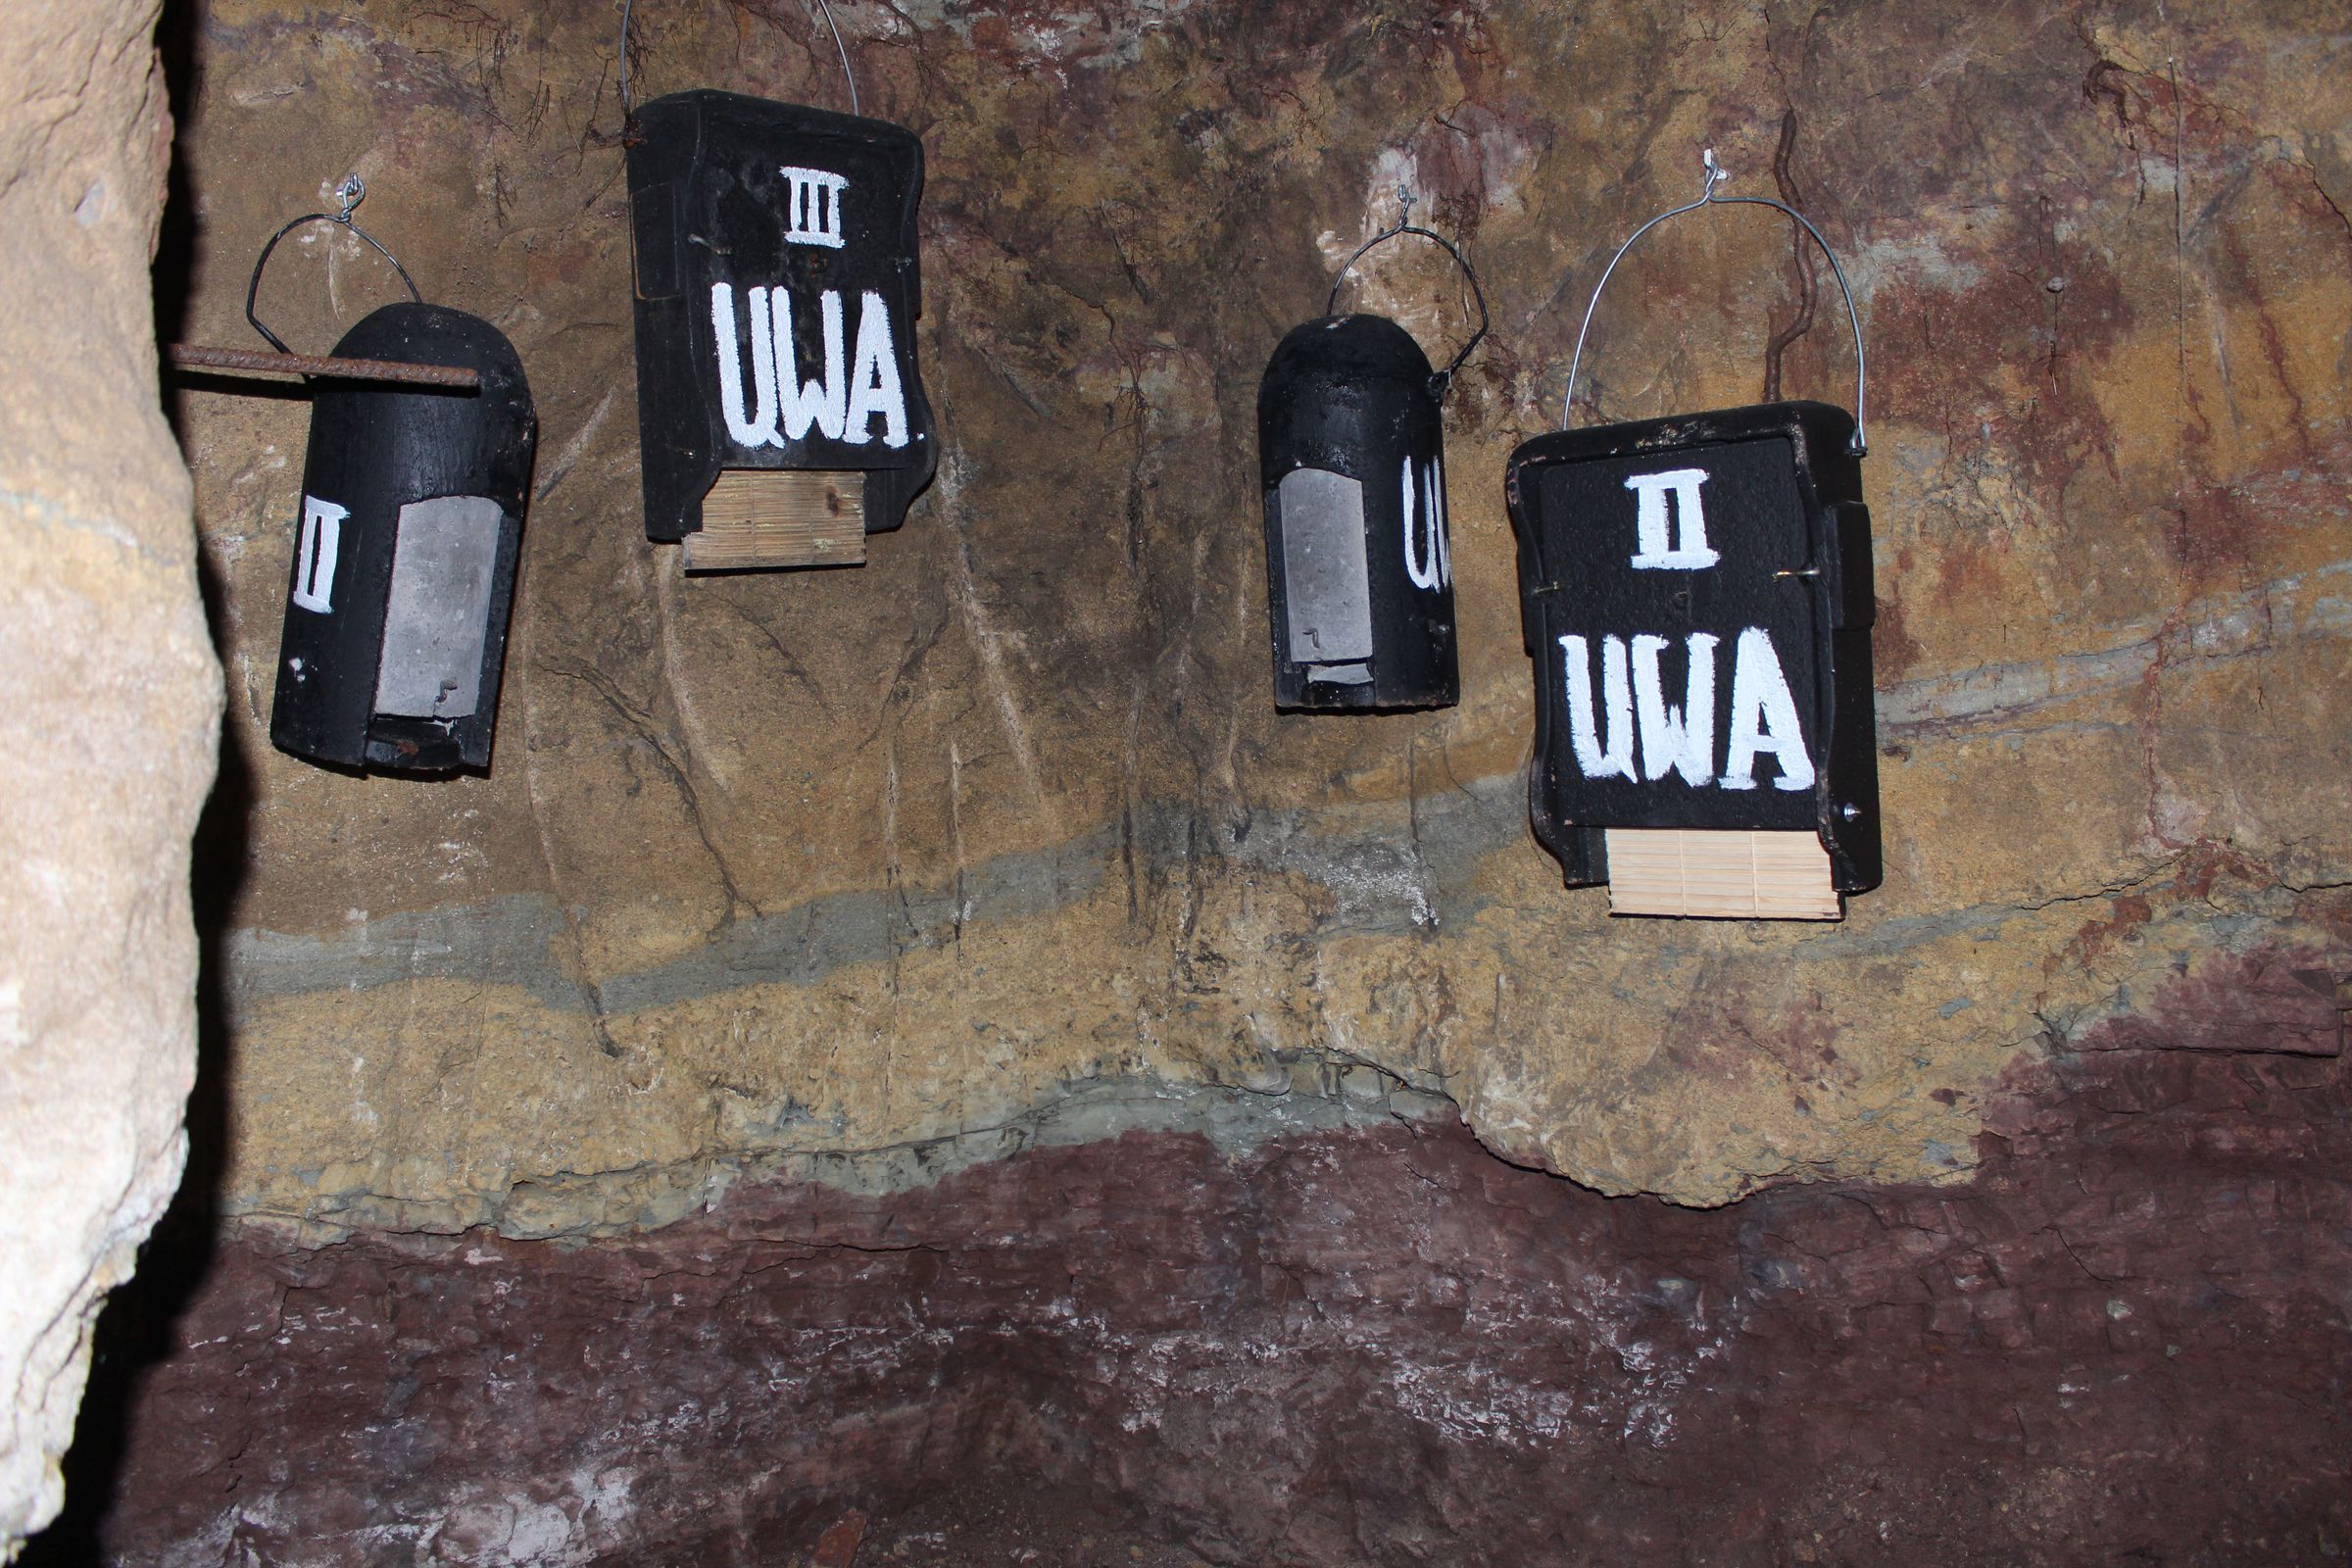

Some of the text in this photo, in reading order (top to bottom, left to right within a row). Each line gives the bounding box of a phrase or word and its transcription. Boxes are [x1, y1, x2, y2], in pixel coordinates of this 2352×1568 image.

[779, 166, 851, 249] III
[1623, 467, 1721, 570] II
[1557, 625, 1816, 792] UWA
